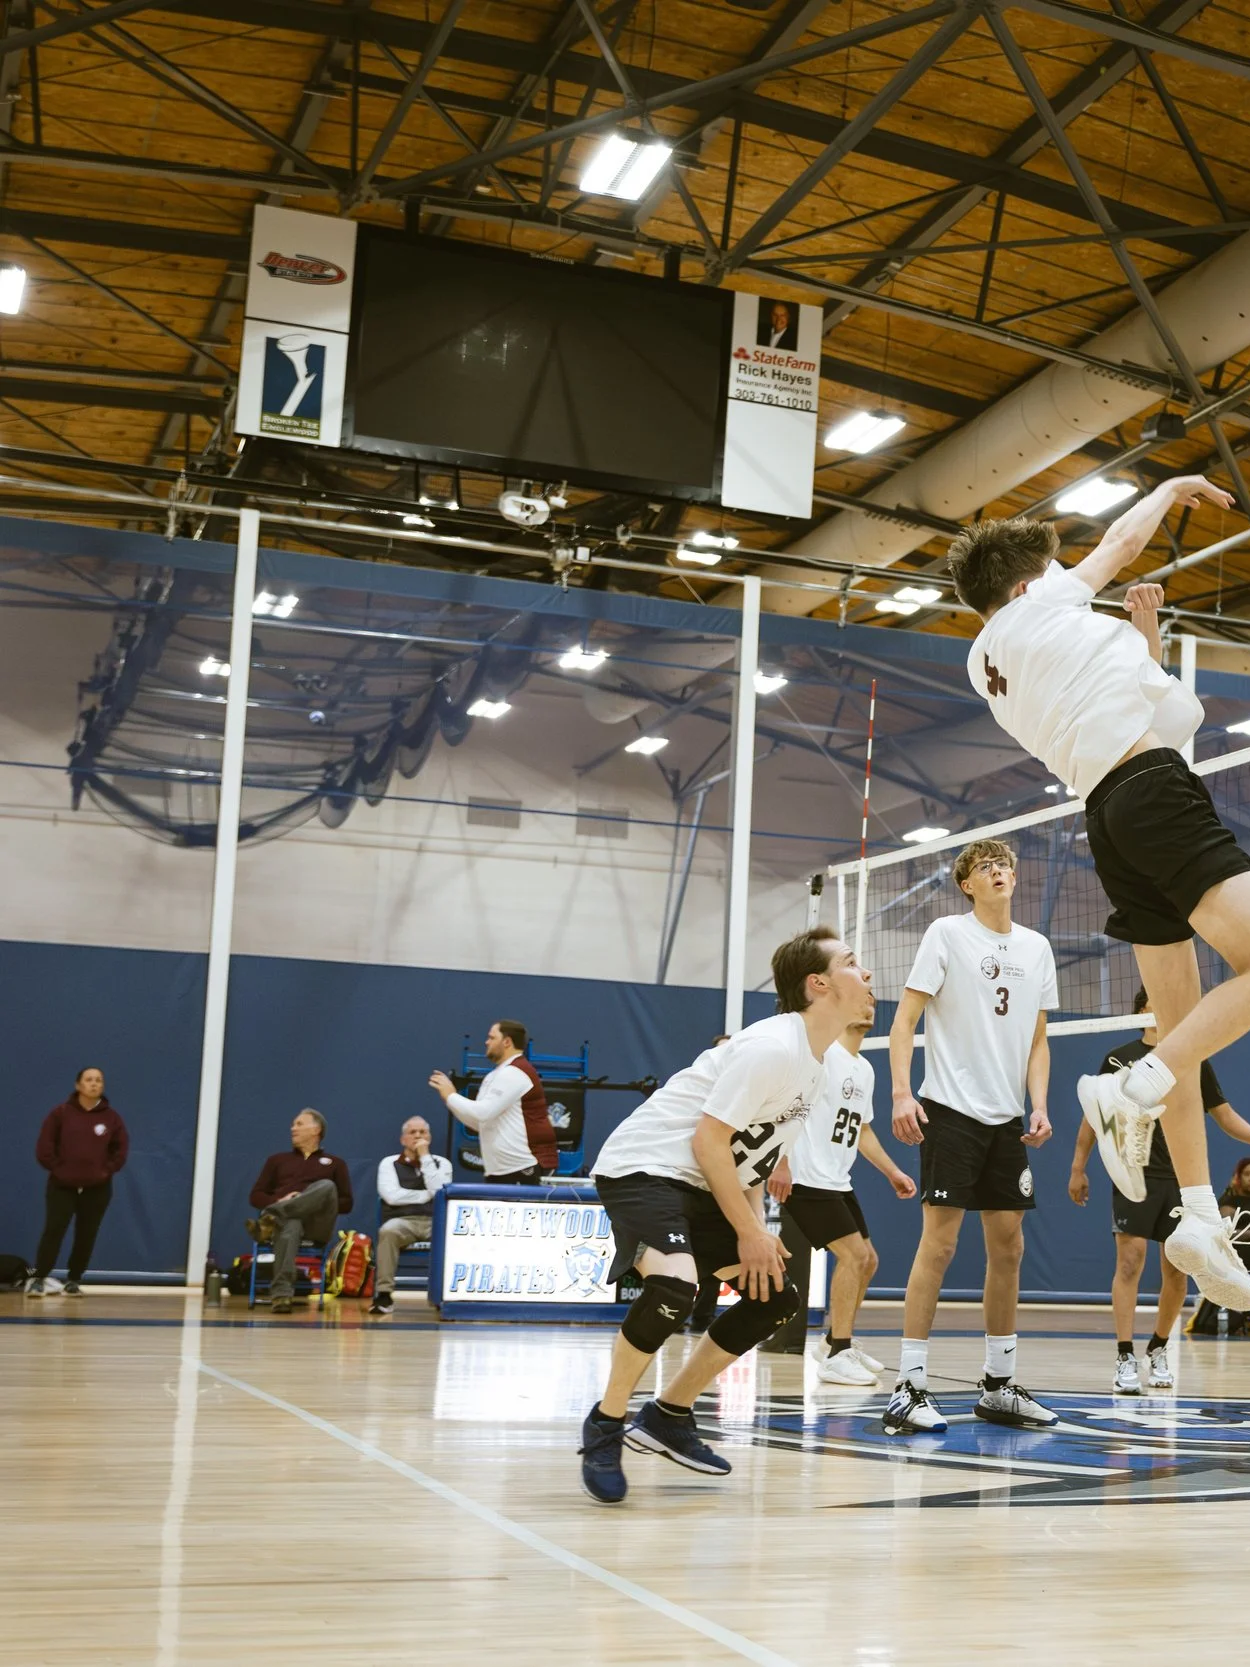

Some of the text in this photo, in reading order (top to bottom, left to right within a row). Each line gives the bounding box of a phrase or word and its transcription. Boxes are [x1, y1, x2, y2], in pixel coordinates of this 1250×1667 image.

[738, 363, 812, 386] Rick Hayes
[735, 388, 812, 410] 303-761-1010
[995, 987, 1010, 1016] 3
[730, 1122, 784, 1188] 24
[452, 1204, 612, 1239] ENGLEWOOD
[450, 1262, 558, 1294] PIRATES
